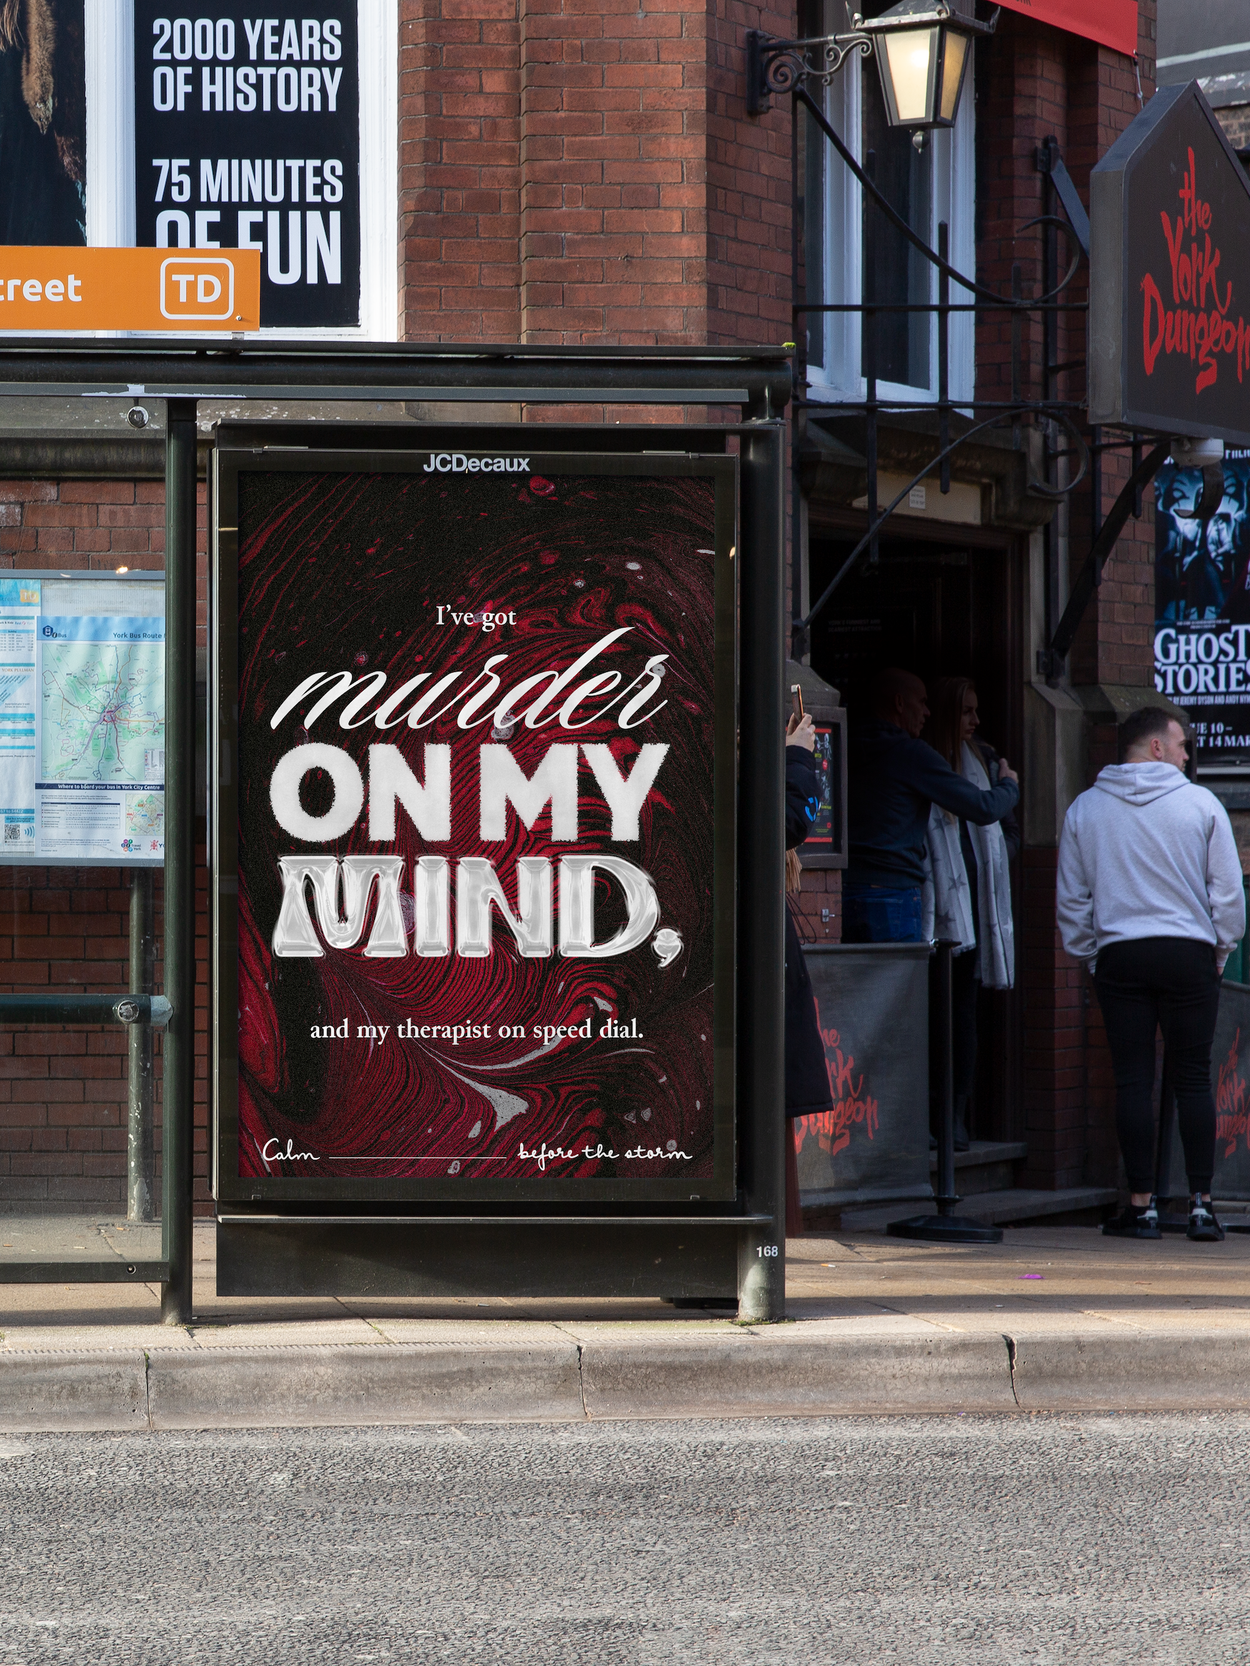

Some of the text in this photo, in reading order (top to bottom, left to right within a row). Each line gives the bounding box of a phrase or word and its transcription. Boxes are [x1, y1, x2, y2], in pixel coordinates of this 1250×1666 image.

[152, 17, 342, 61] 2000 YEARS
[152, 66, 343, 112] OF HISTORY
[152, 159, 344, 203] 75 MINUTES
[1160, 211, 1232, 315] York
[171, 273, 223, 303] TD
[423, 453, 531, 473] JCDecaux
[436, 605, 517, 632] I’ve got
[1153, 624, 1250, 664] GHOST
[269, 626, 670, 731] murder
[1209, 735, 1222, 748] 14
[1211, 722, 1224, 734] 10
[269, 741, 670, 842] ON MY
[272, 854, 684, 968] MIND,
[310, 1019, 644, 1045] and my therapist on speed dial.
[261, 1137, 321, 1163] Calm
[517, 1142, 693, 1172] before the storm
[756, 1245, 778, 1258] 168
